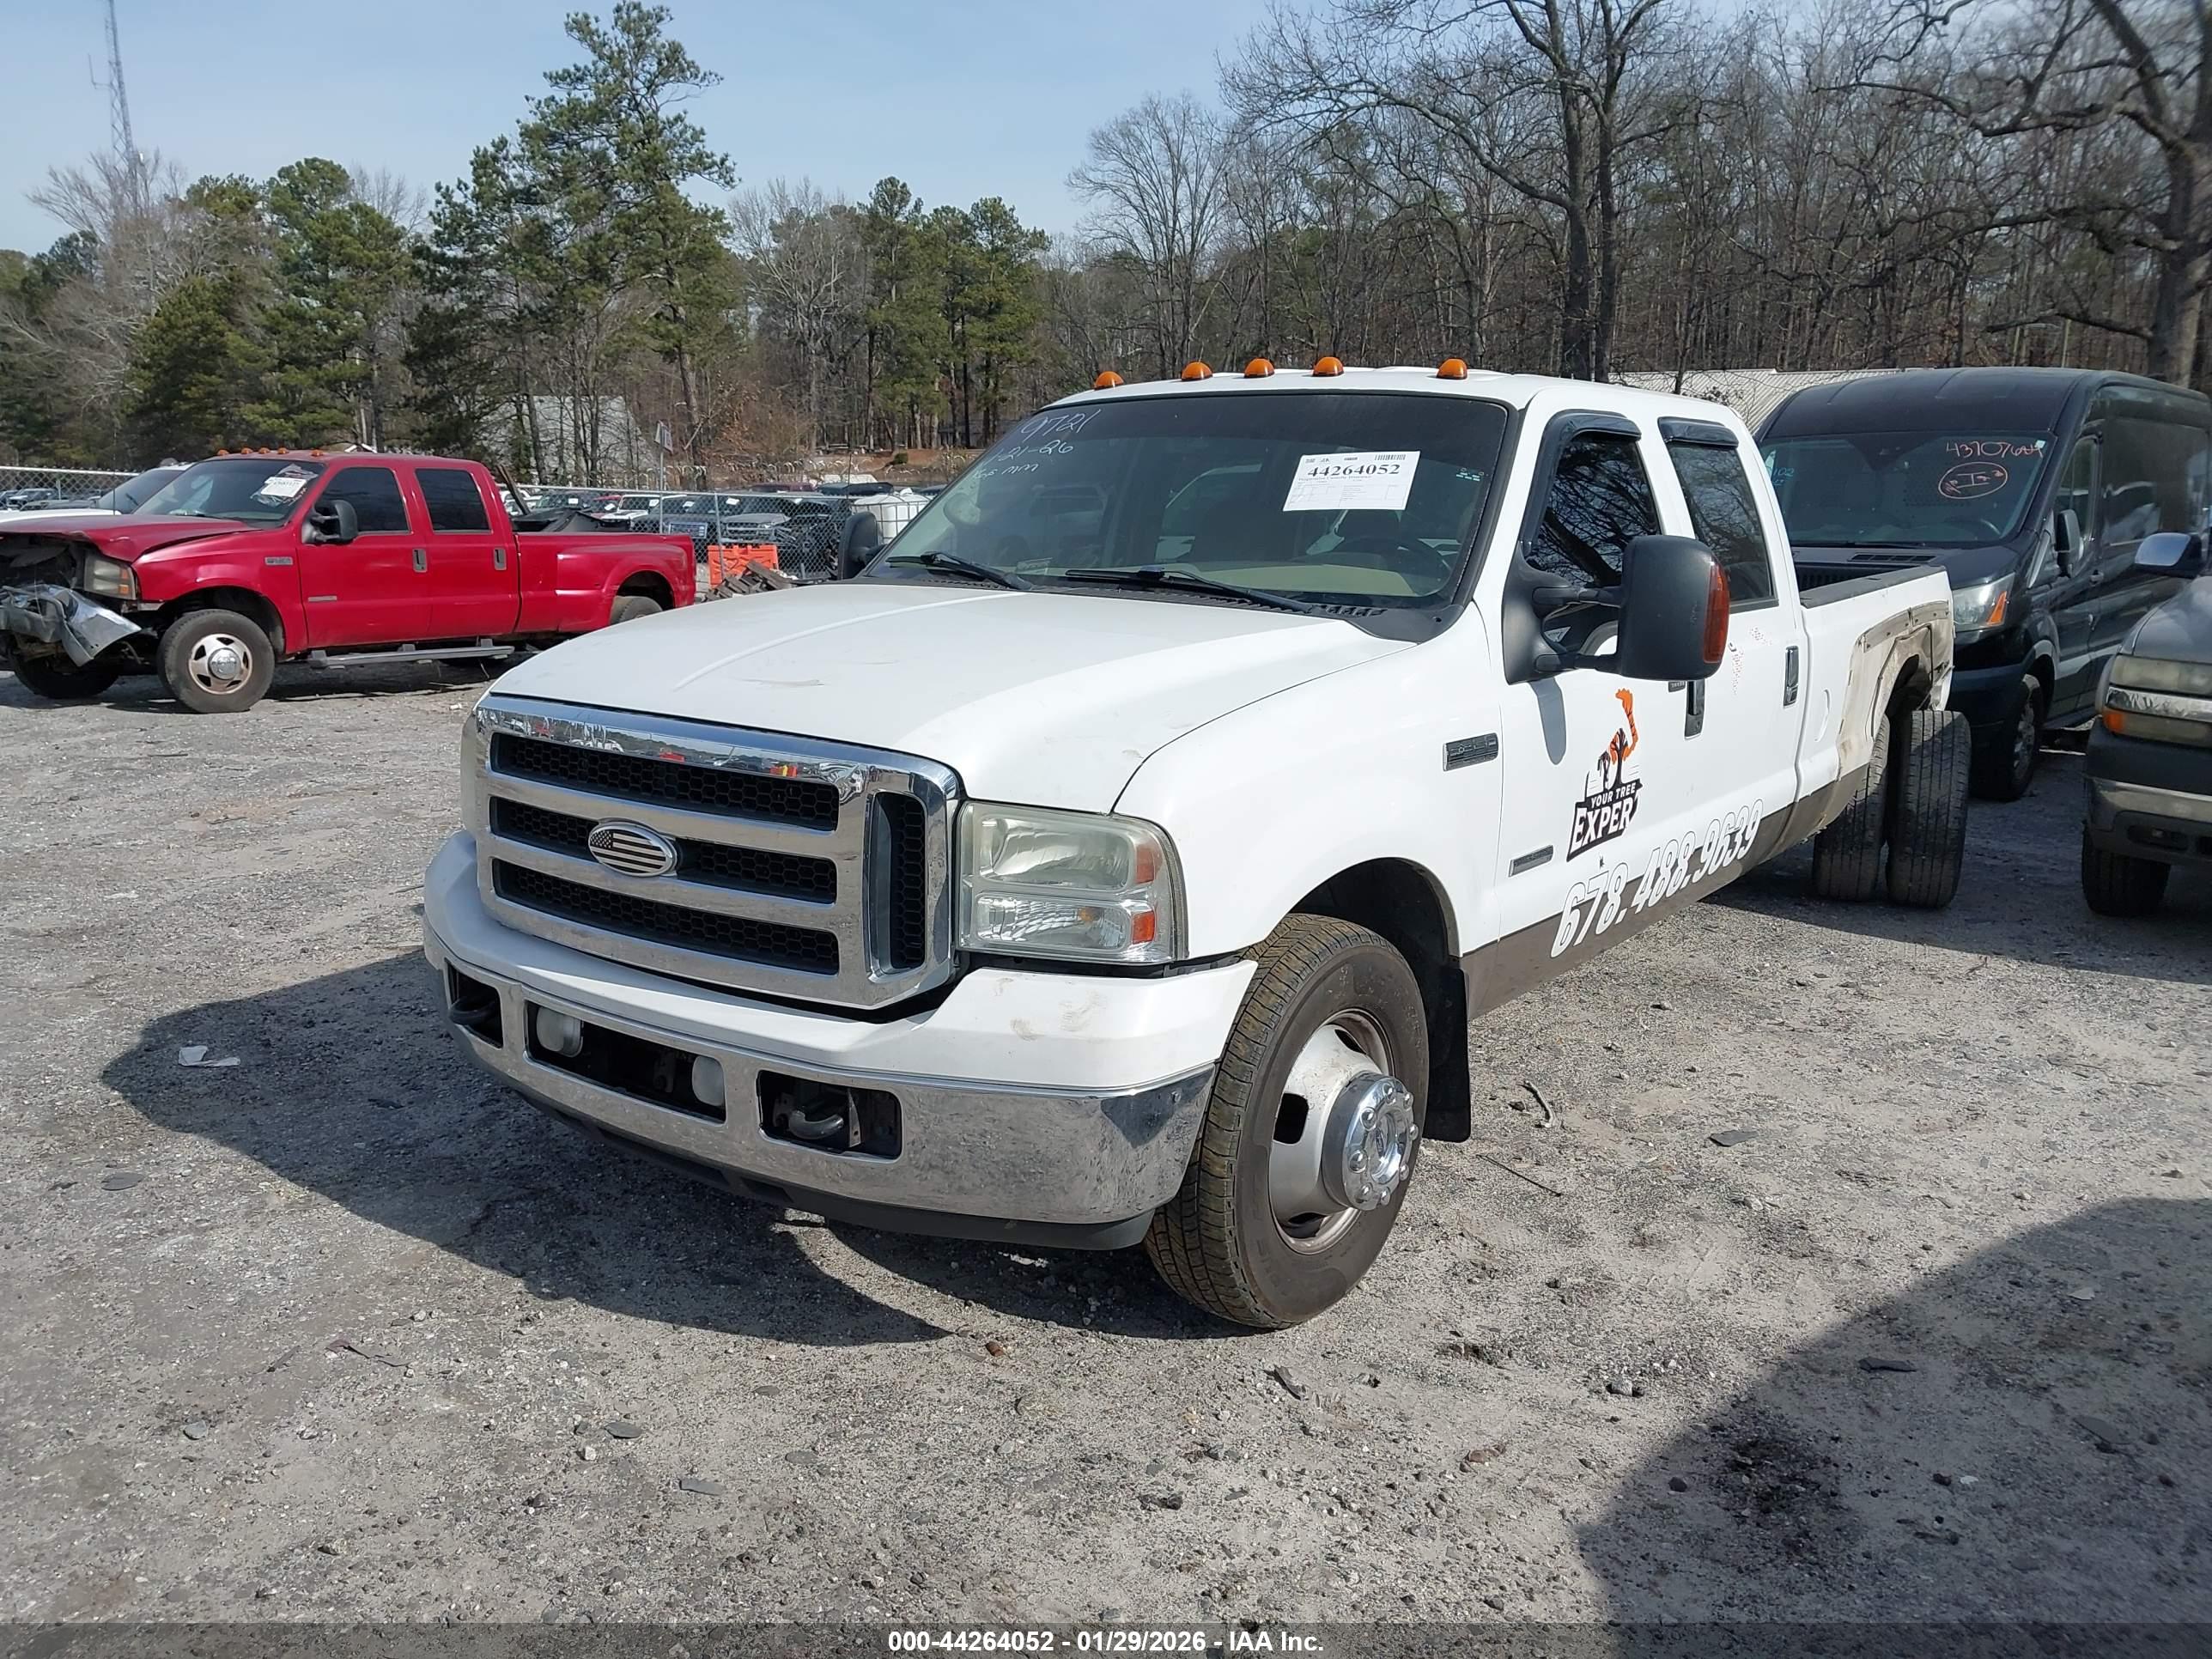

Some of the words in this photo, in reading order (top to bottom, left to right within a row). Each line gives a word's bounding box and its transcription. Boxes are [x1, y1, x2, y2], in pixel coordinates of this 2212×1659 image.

[1307, 464, 1401, 477] 44264052
[1591, 790, 1613, 808] YOUR
[1616, 782, 1637, 799] TREE
[1550, 799, 1764, 957] 678.488.9639
